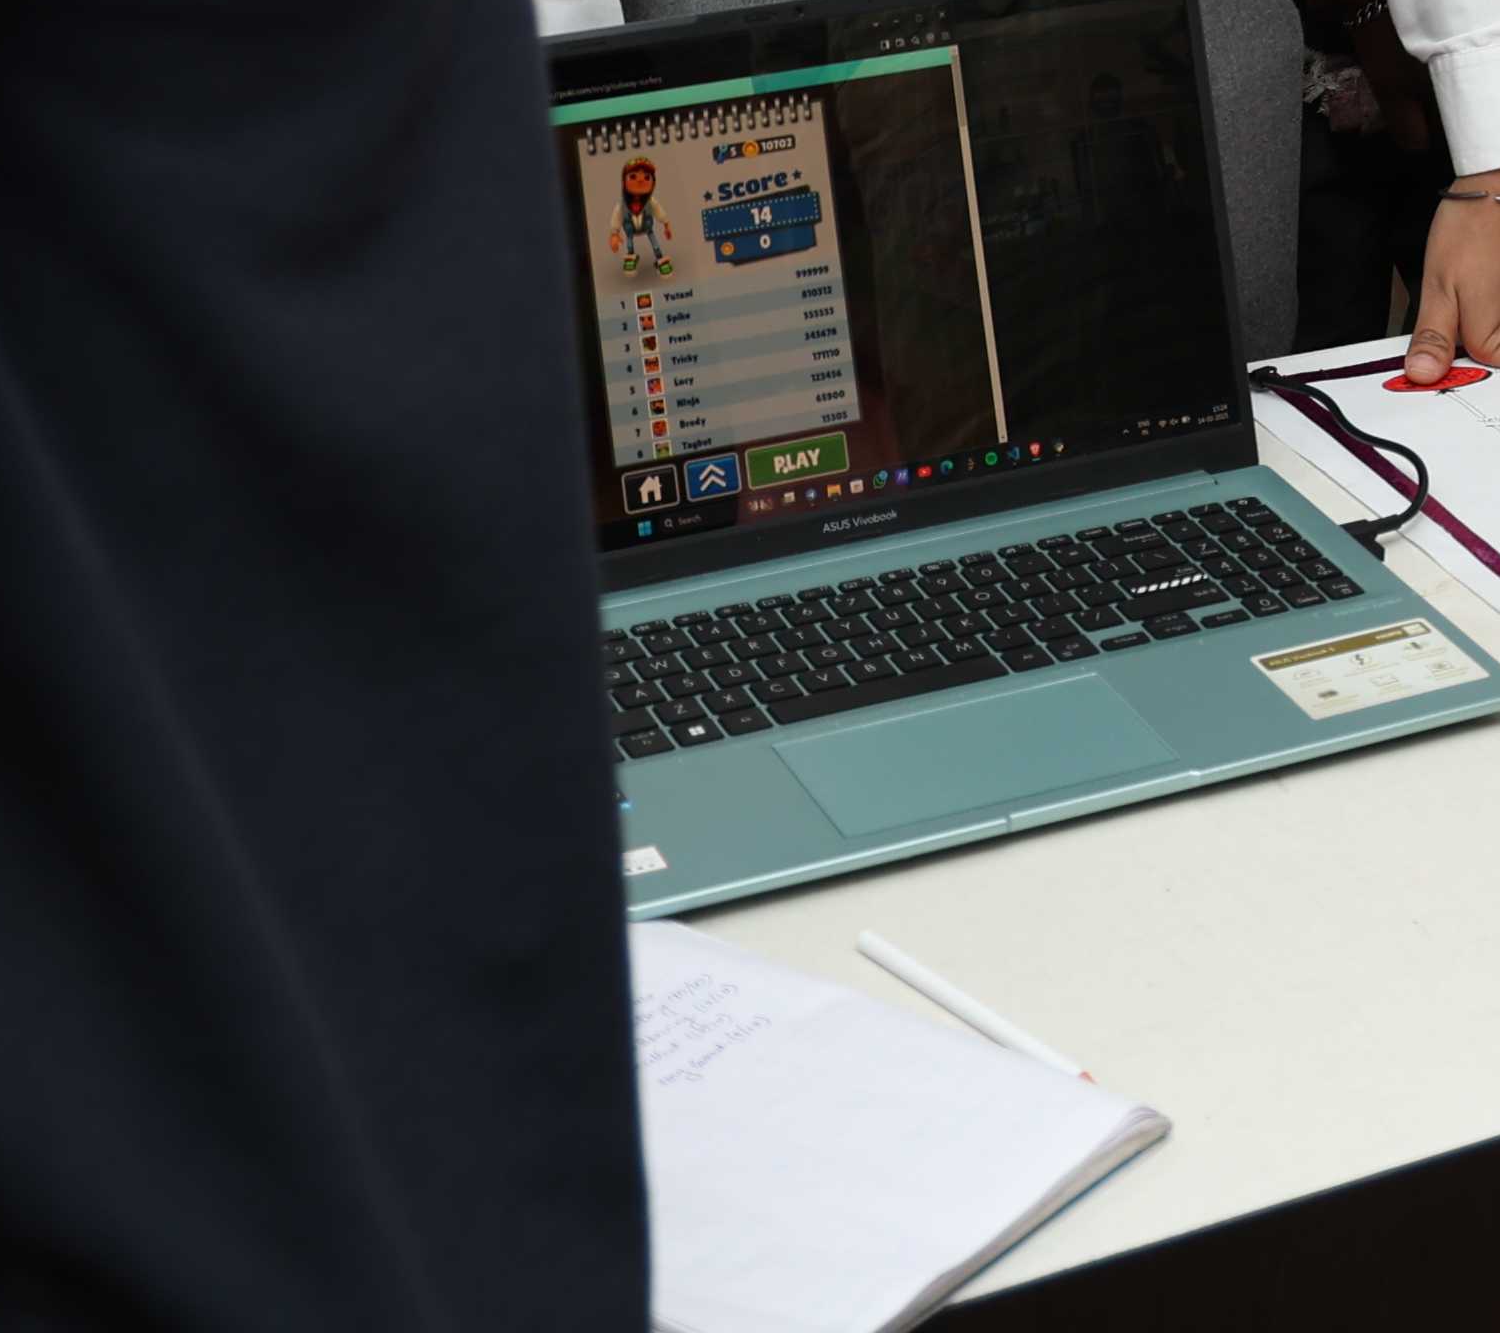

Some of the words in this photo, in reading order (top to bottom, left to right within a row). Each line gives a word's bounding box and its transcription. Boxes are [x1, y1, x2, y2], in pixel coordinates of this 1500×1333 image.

[718, 172, 788, 201] Score
[751, 206, 773, 225] 14
[760, 234, 771, 249] 0
[773, 447, 821, 474] PLAY
[822, 519, 851, 534] ASUS
[852, 509, 898, 528] Vivobook
[936, 577, 947, 587] 9
[650, 659, 669, 671] W
[702, 650, 714, 660] E
[748, 640, 760, 651] R
[840, 620, 851, 632] Y
[885, 611, 900, 622] U
[974, 591, 991, 602] O
[1020, 581, 1031, 592] P
[634, 689, 648, 699] A
[682, 678, 695, 688] S
[728, 668, 743, 678] D
[777, 658, 787, 670] F
[820, 647, 839, 660] G
[867, 638, 884, 649] H
[959, 618, 973, 628] K
[1005, 608, 1019, 618] L
[673, 703, 688, 715] Z
[722, 693, 735, 704] X
[770, 682, 787, 694] C
[815, 672, 830, 684] V
[863, 662, 878, 674] B
[908, 652, 925, 664] N
[955, 642, 973, 654] M
